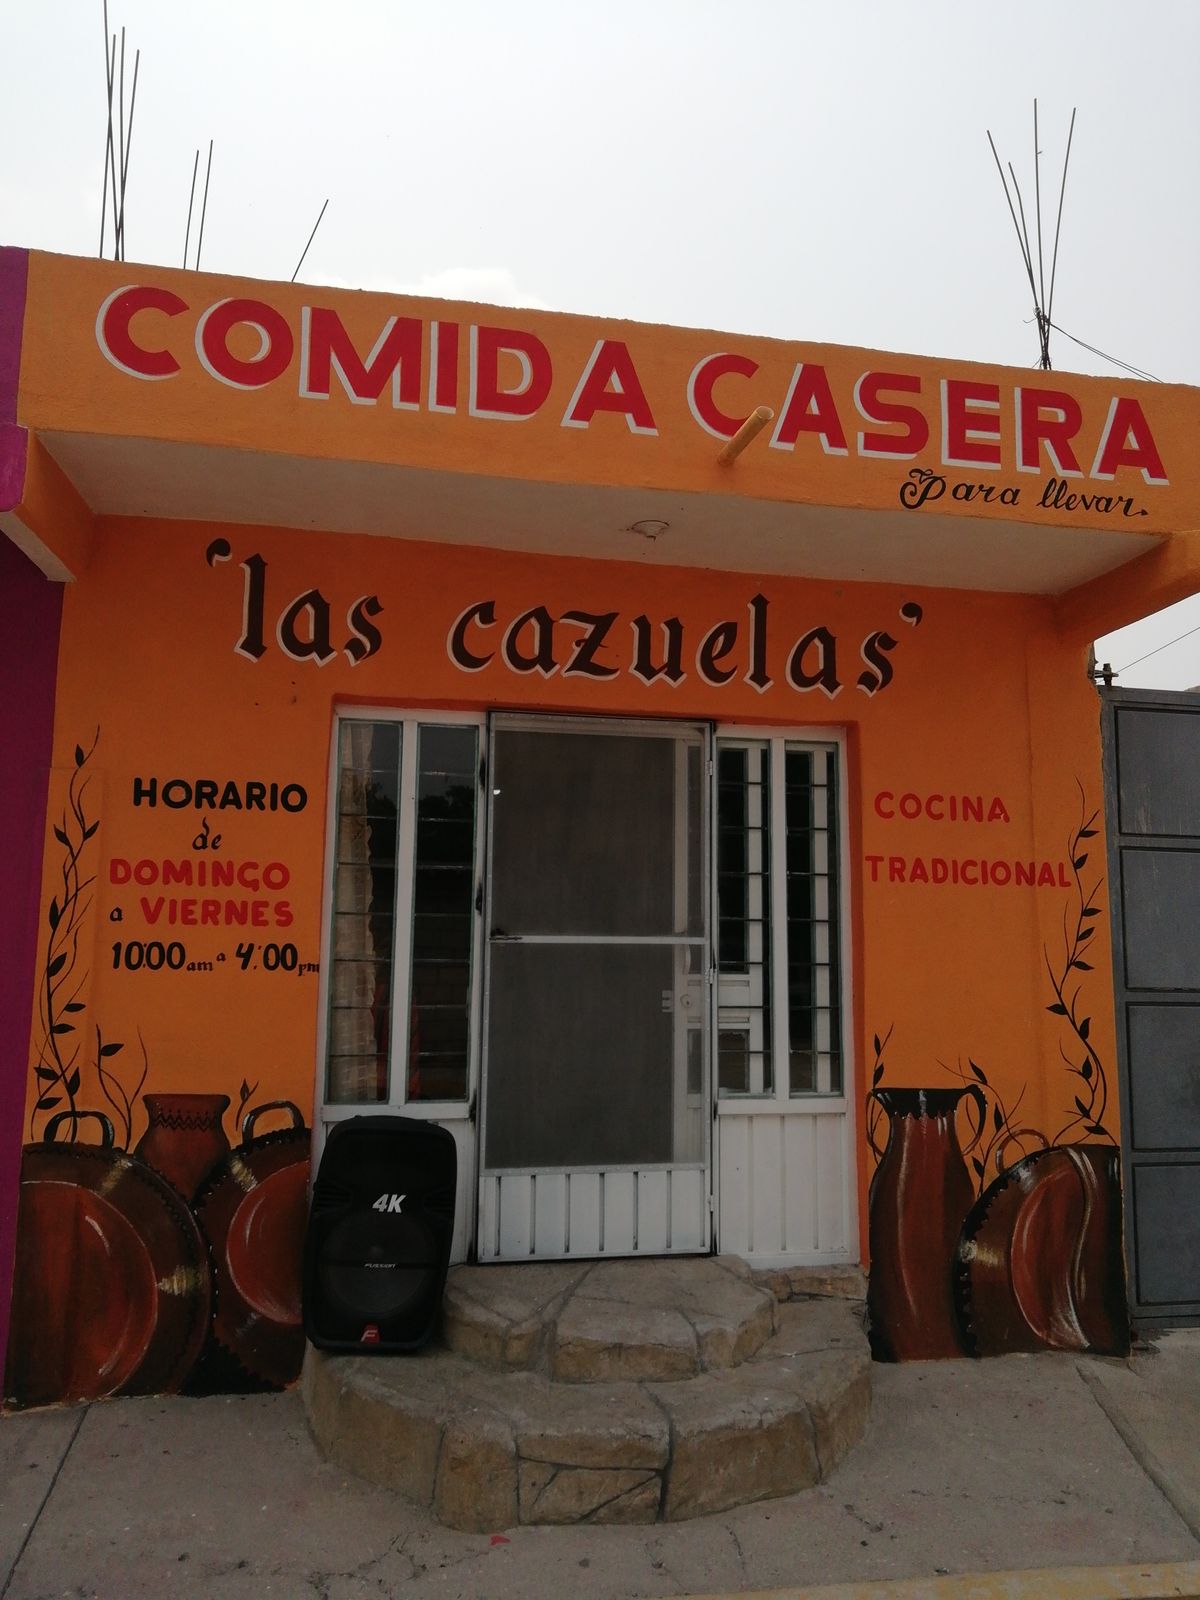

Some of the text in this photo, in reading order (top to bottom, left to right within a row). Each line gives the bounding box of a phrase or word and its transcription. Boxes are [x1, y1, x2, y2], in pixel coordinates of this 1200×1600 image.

[95, 284, 1170, 486] COMIDA CASERA
[899, 468, 1020, 510] Para
[132, 777, 308, 813] HORARIO
[873, 791, 1011, 824] COCINA
[191, 815, 223, 851] de
[109, 857, 291, 893] DOMINGO
[864, 855, 1072, 888] TRADICIONAL
[109, 896, 295, 928] a VIERNES
[372, 1193, 407, 1214] 4K
